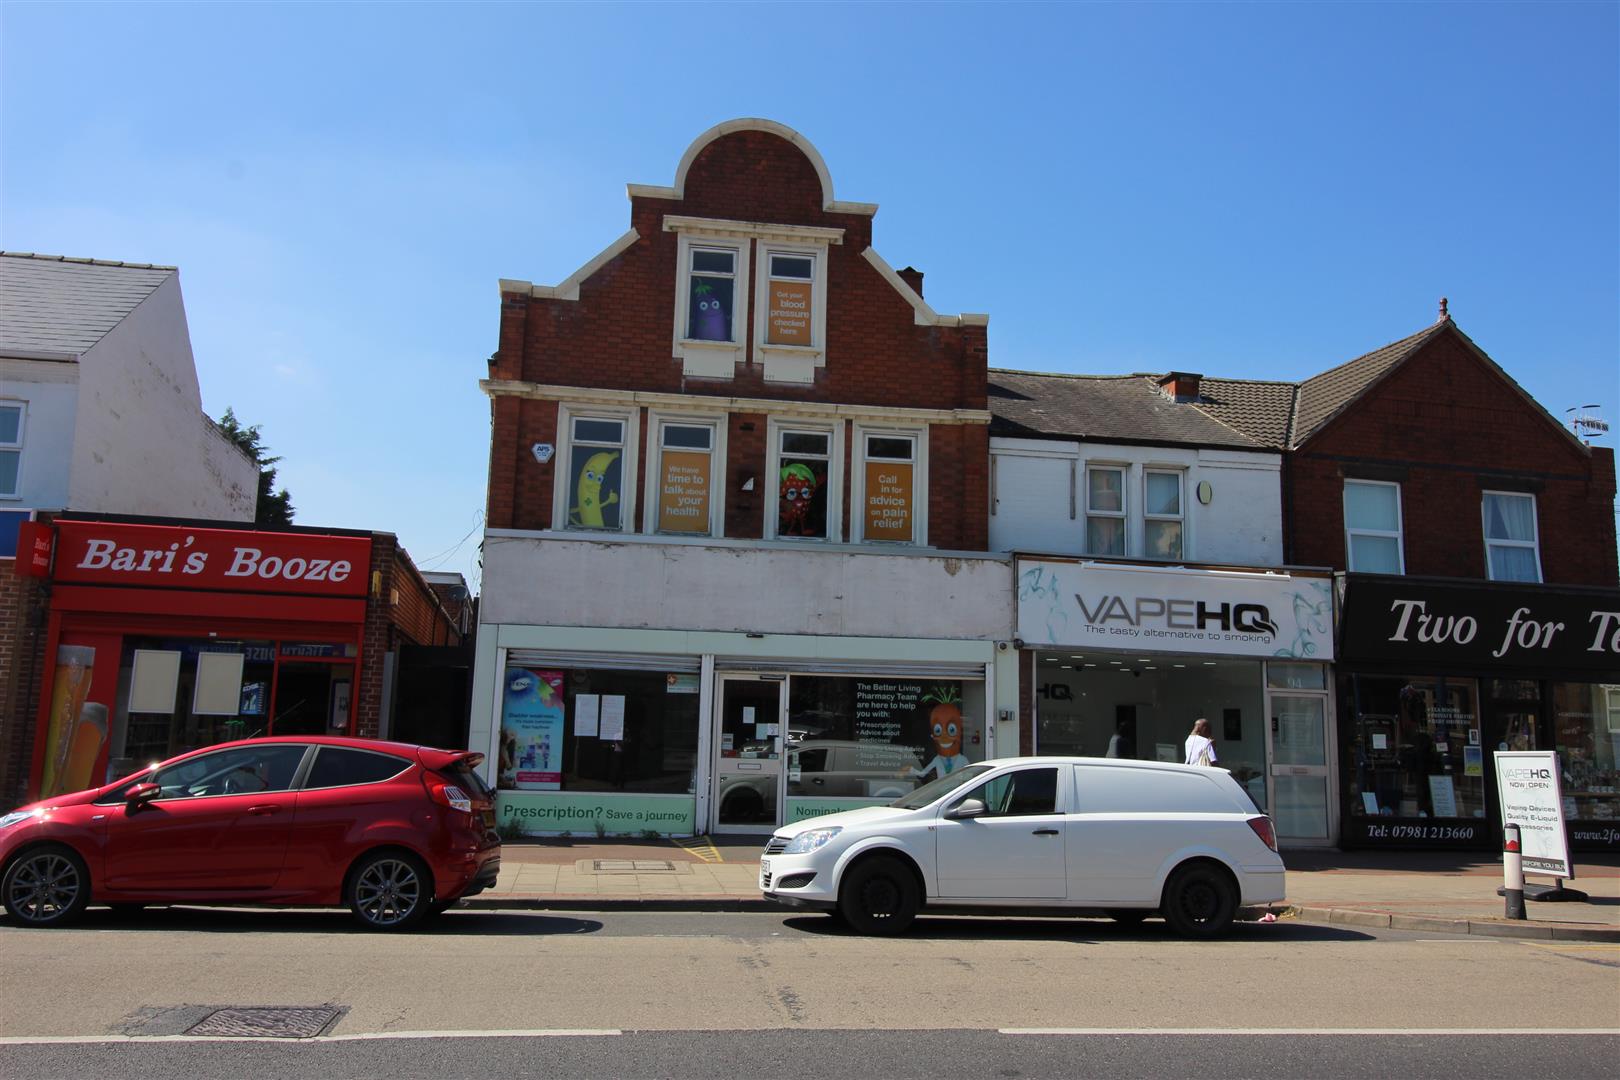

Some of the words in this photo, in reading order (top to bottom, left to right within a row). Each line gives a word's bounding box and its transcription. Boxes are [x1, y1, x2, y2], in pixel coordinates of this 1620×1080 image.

[780, 300, 805, 308] blood
[770, 310, 810, 318] pressure
[780, 327, 797, 335] here
[667, 474, 689, 483] time
[693, 475, 704, 484] to
[878, 474, 897, 483] Call
[665, 484, 684, 494] talk
[687, 488, 706, 496] about
[881, 485, 890, 493] in
[678, 497, 704, 507] your
[870, 496, 905, 505] advice
[666, 505, 699, 516] health
[883, 508, 907, 519] pain
[873, 518, 904, 528] relief
[77, 536, 208, 575] Bari's
[224, 547, 352, 582] Booze
[1388, 599, 1477, 645] Two
[1492, 607, 1566, 658] for
[1084, 624, 1106, 634] The
[1110, 627, 1140, 637] tasty
[1144, 629, 1204, 640] alternative
[1208, 633, 1221, 641] to
[1224, 633, 1271, 644] smoking
[898, 684, 921, 693] Living
[857, 692, 895, 701] Pharmacy
[897, 692, 917, 700] Team
[899, 702, 916, 711] help
[504, 804, 603, 820] Prescription?
[606, 809, 633, 819] Save
[636, 812, 643, 820] a
[645, 811, 688, 822] journey
[1507, 813, 1528, 821] Quality
[1367, 825, 1388, 837] Tel:
[1392, 826, 1427, 838] 07981
[1430, 827, 1474, 839] 213660
